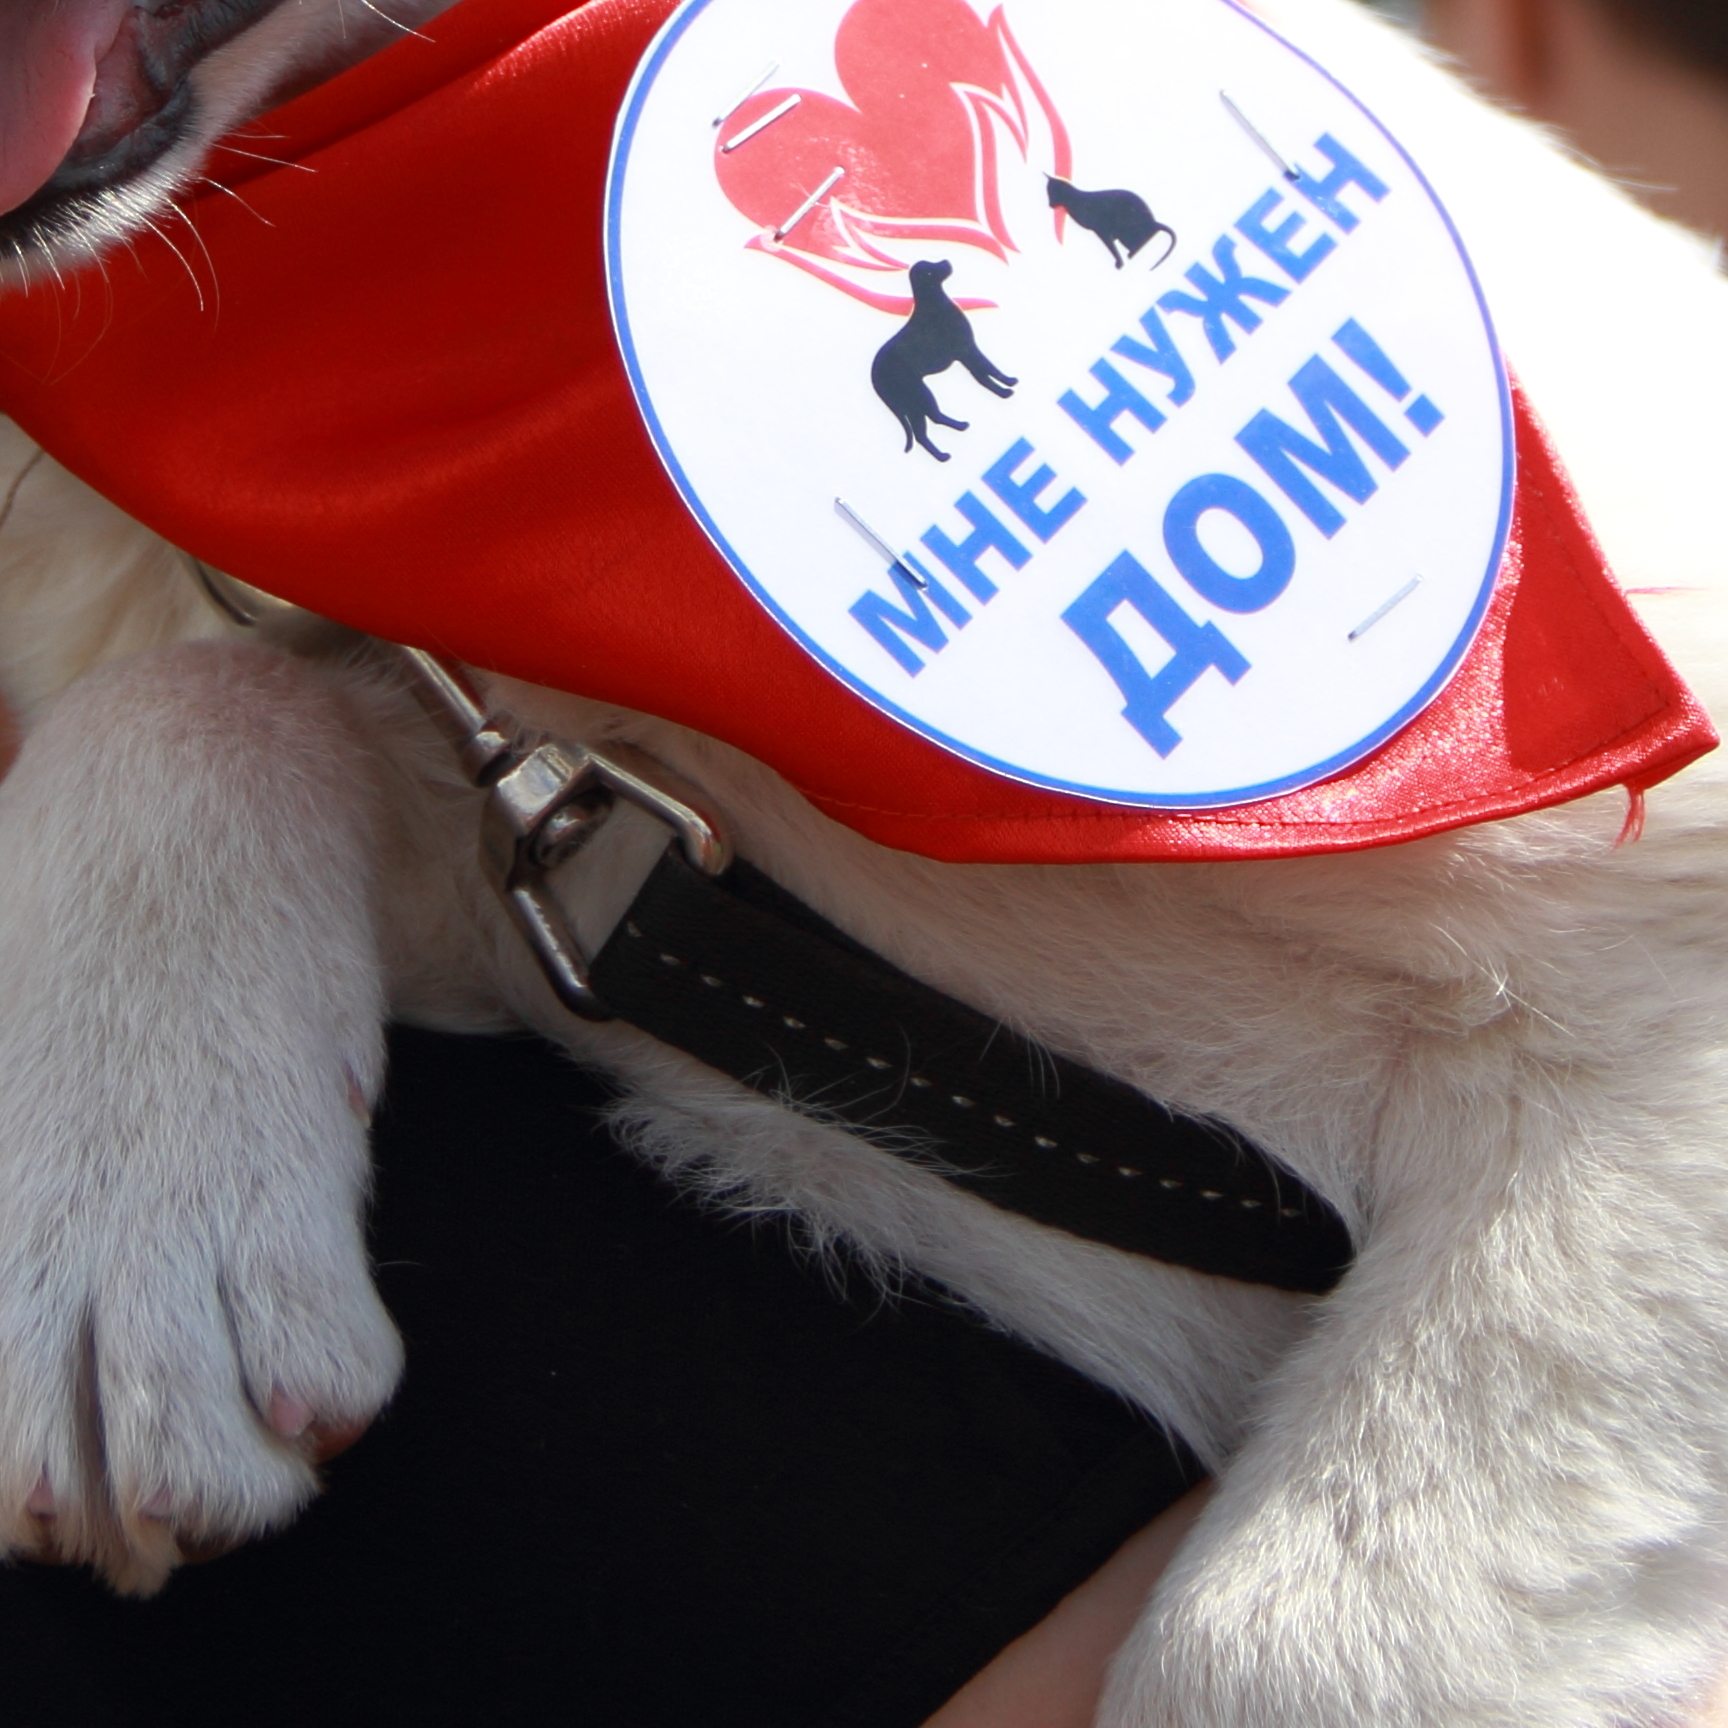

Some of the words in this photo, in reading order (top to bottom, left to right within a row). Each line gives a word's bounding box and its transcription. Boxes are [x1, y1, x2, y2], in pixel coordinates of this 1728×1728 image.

[847, 436, 1088, 677] МНЕ
[1056, 132, 1391, 466] НУЖЕН
[1059, 317, 1445, 758] ДОМ!
